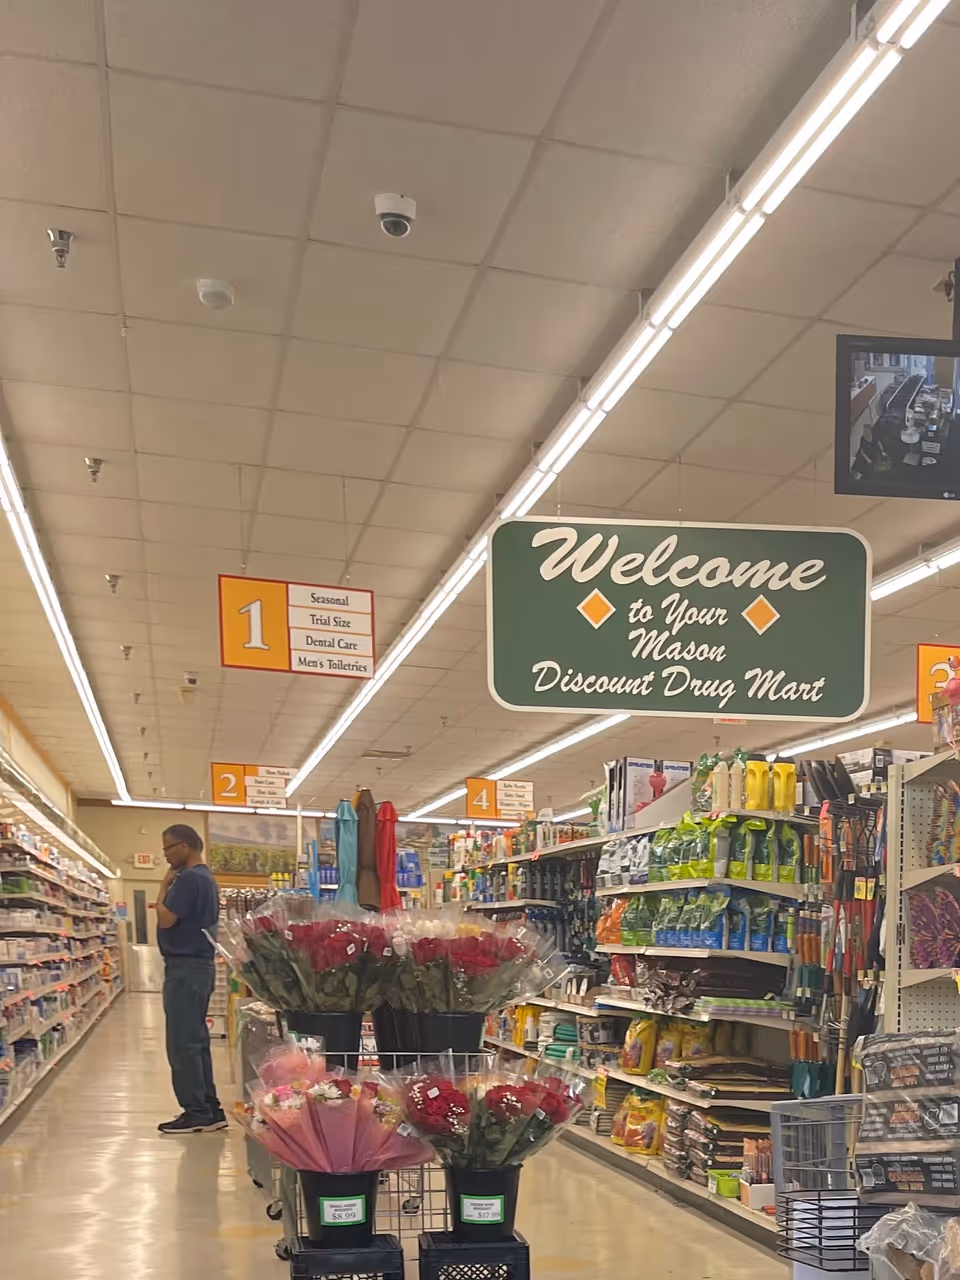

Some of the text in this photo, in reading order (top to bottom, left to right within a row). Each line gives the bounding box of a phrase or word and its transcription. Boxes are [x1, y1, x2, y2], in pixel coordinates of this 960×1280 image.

[531, 527, 826, 591] Welcome
[310, 592, 348, 606] Seasonal
[238, 598, 271, 651] 1
[309, 613, 351, 629] Trial Size
[628, 592, 728, 635] to Your
[305, 635, 358, 651] Dental Care
[628, 628, 726, 662] Mason
[297, 655, 368, 673] Men's Toiletries
[531, 660, 826, 708] Discount Drug Mart
[217, 773, 238, 797] 2
[472, 788, 490, 810] 4
